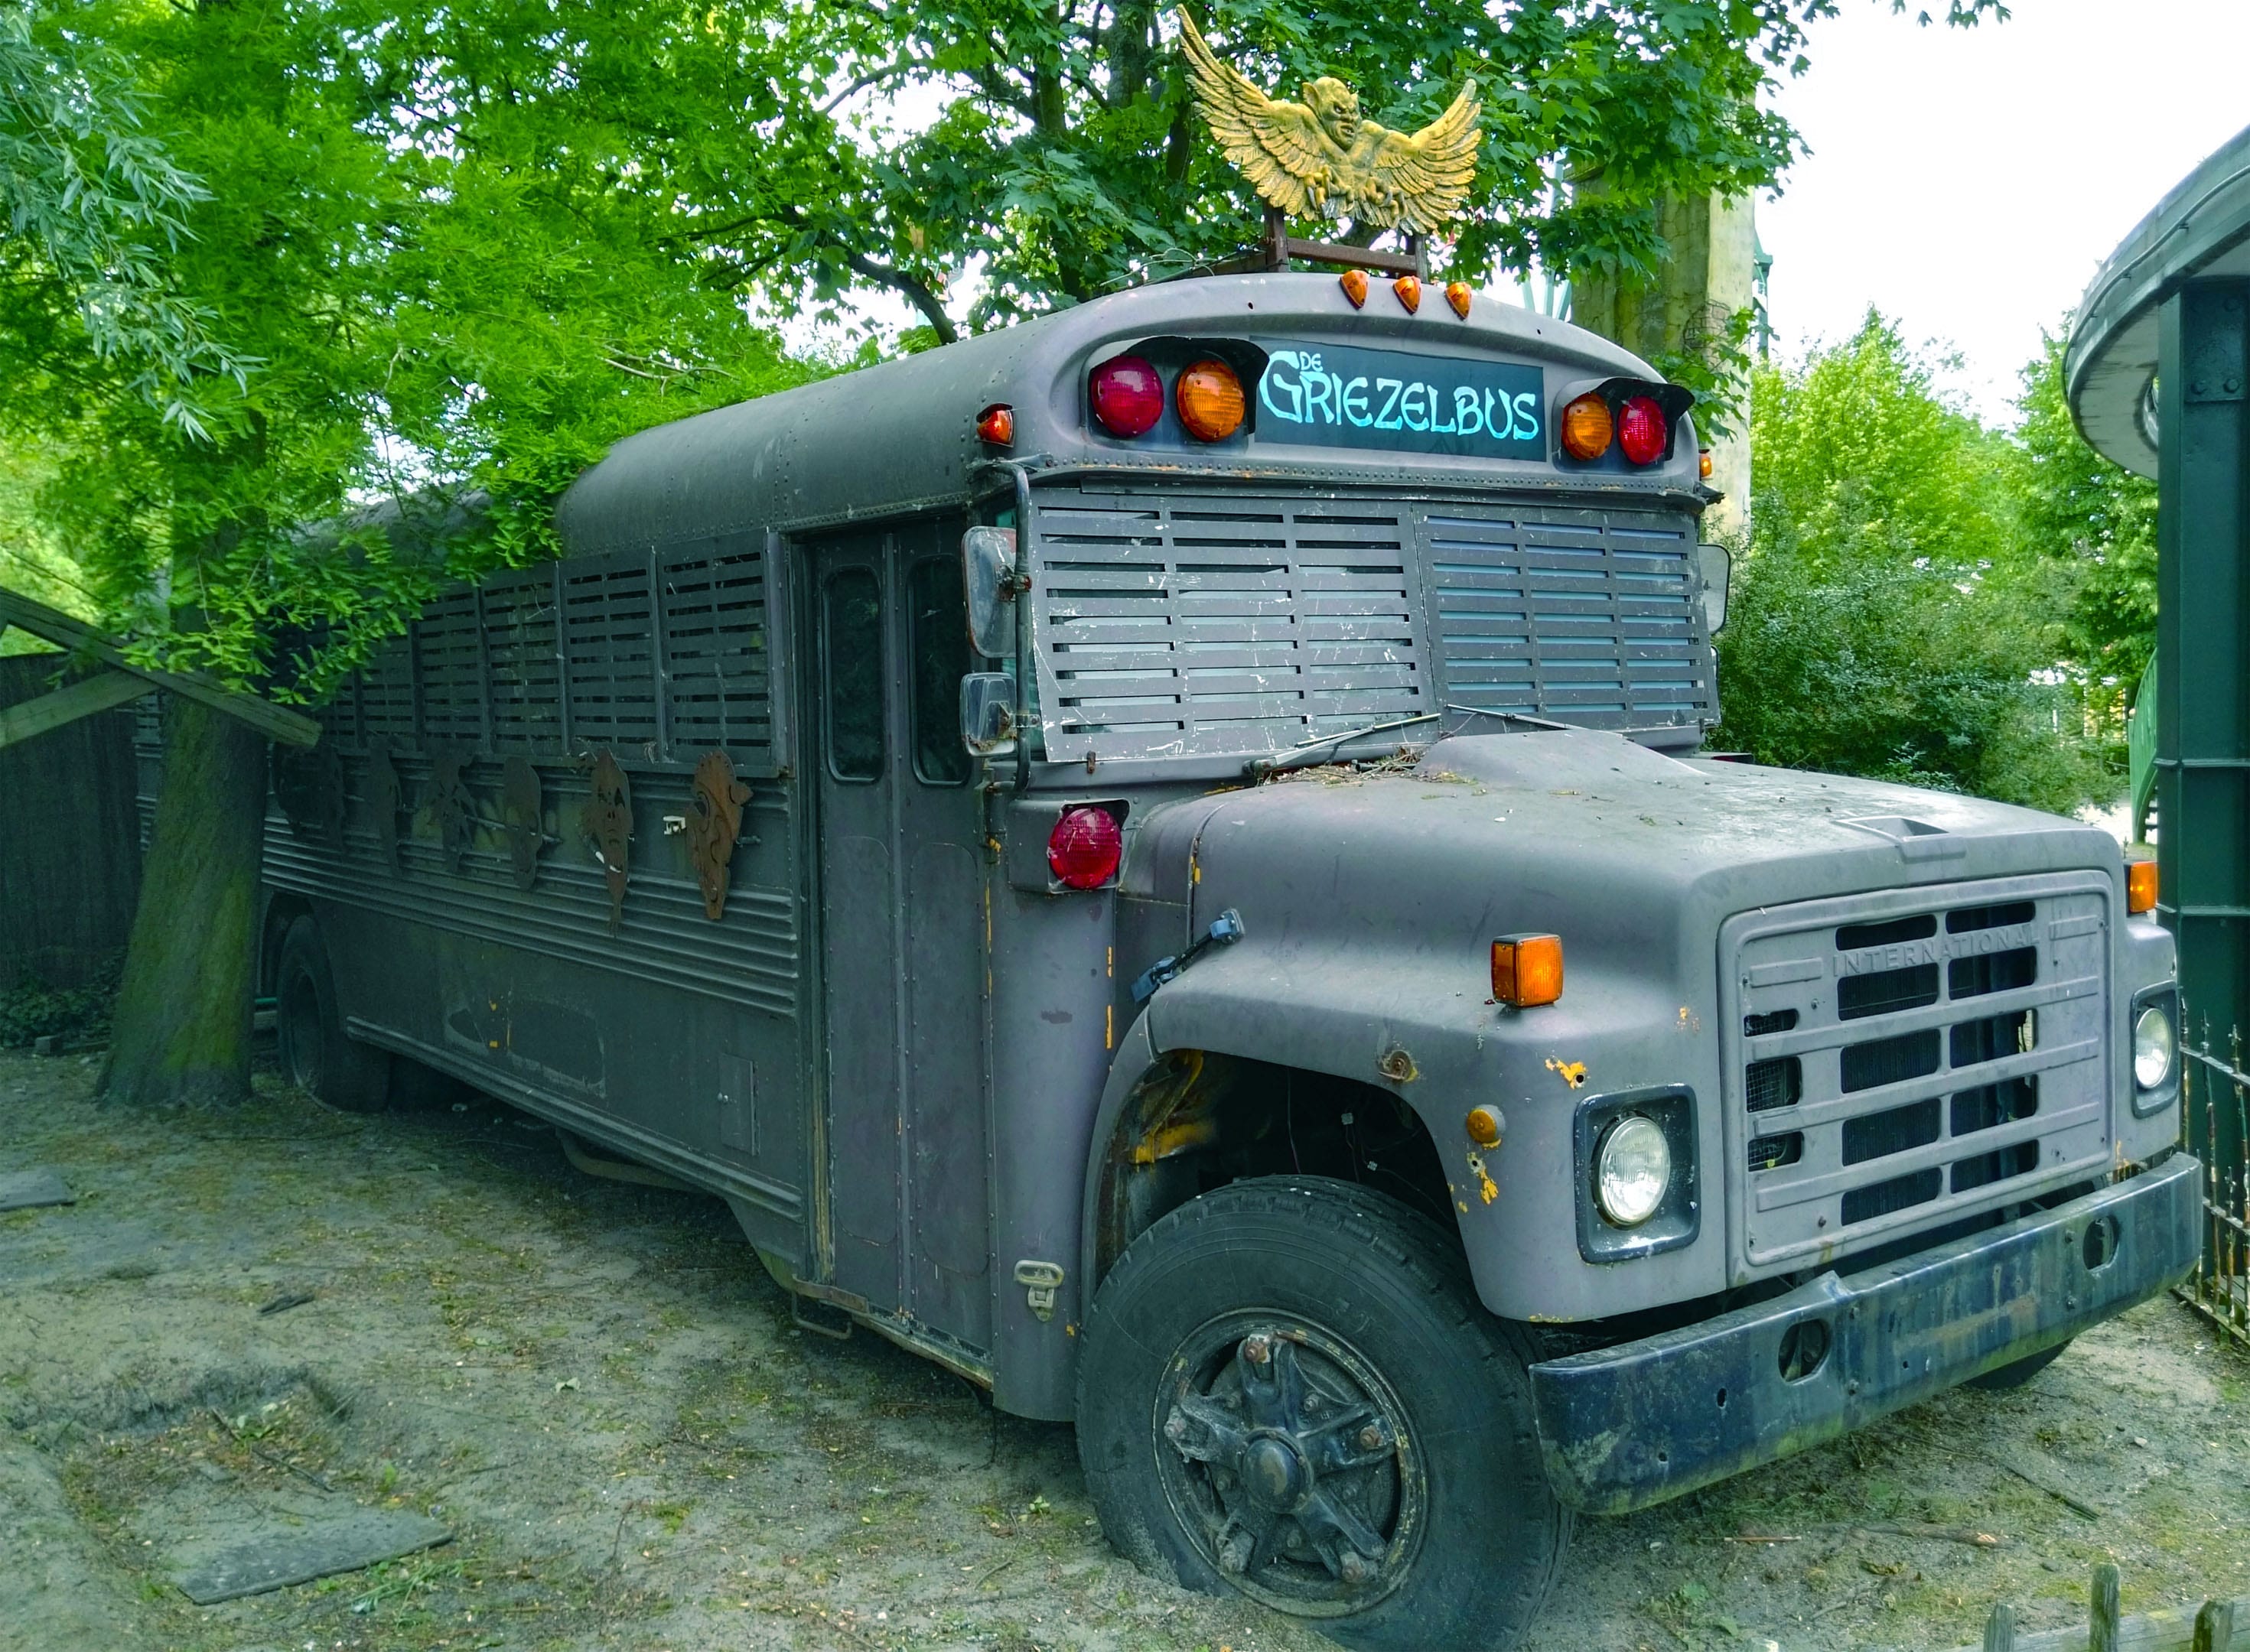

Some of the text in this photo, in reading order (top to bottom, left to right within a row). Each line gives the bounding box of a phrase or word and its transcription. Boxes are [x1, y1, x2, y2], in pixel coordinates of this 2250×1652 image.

[1299, 351, 1324, 372] DE
[1259, 350, 1539, 440] GRIEZELBUS
[1832, 922, 2040, 977] INTERNATIONAL
